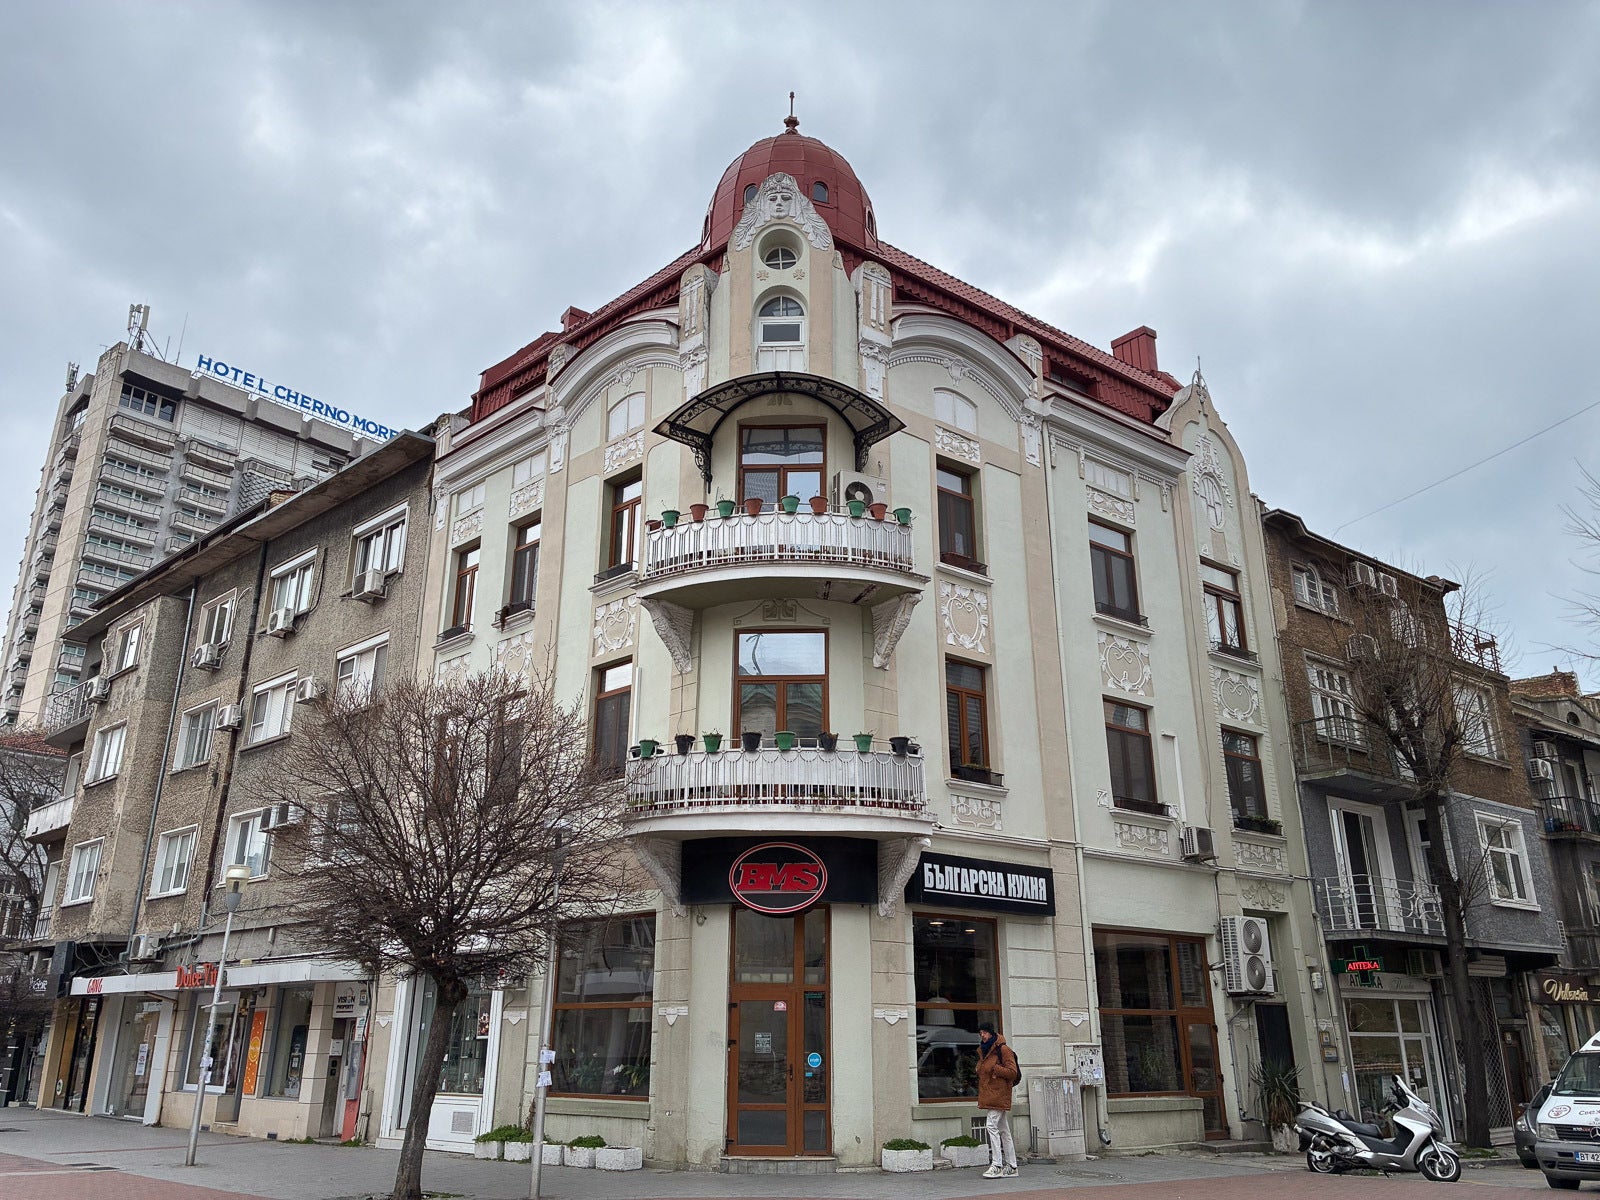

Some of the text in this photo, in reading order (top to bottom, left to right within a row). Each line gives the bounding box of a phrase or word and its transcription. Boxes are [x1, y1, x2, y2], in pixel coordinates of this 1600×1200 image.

[198, 354, 268, 394] HOTEL
[274, 385, 350, 423] CHERNO
[736, 862, 820, 892] BMS
[923, 862, 1047, 901] БЪЛГАРСКА КУХНЯ
[175, 963, 202, 988] Dolce
[1347, 960, 1379, 971] АПТЕКА
